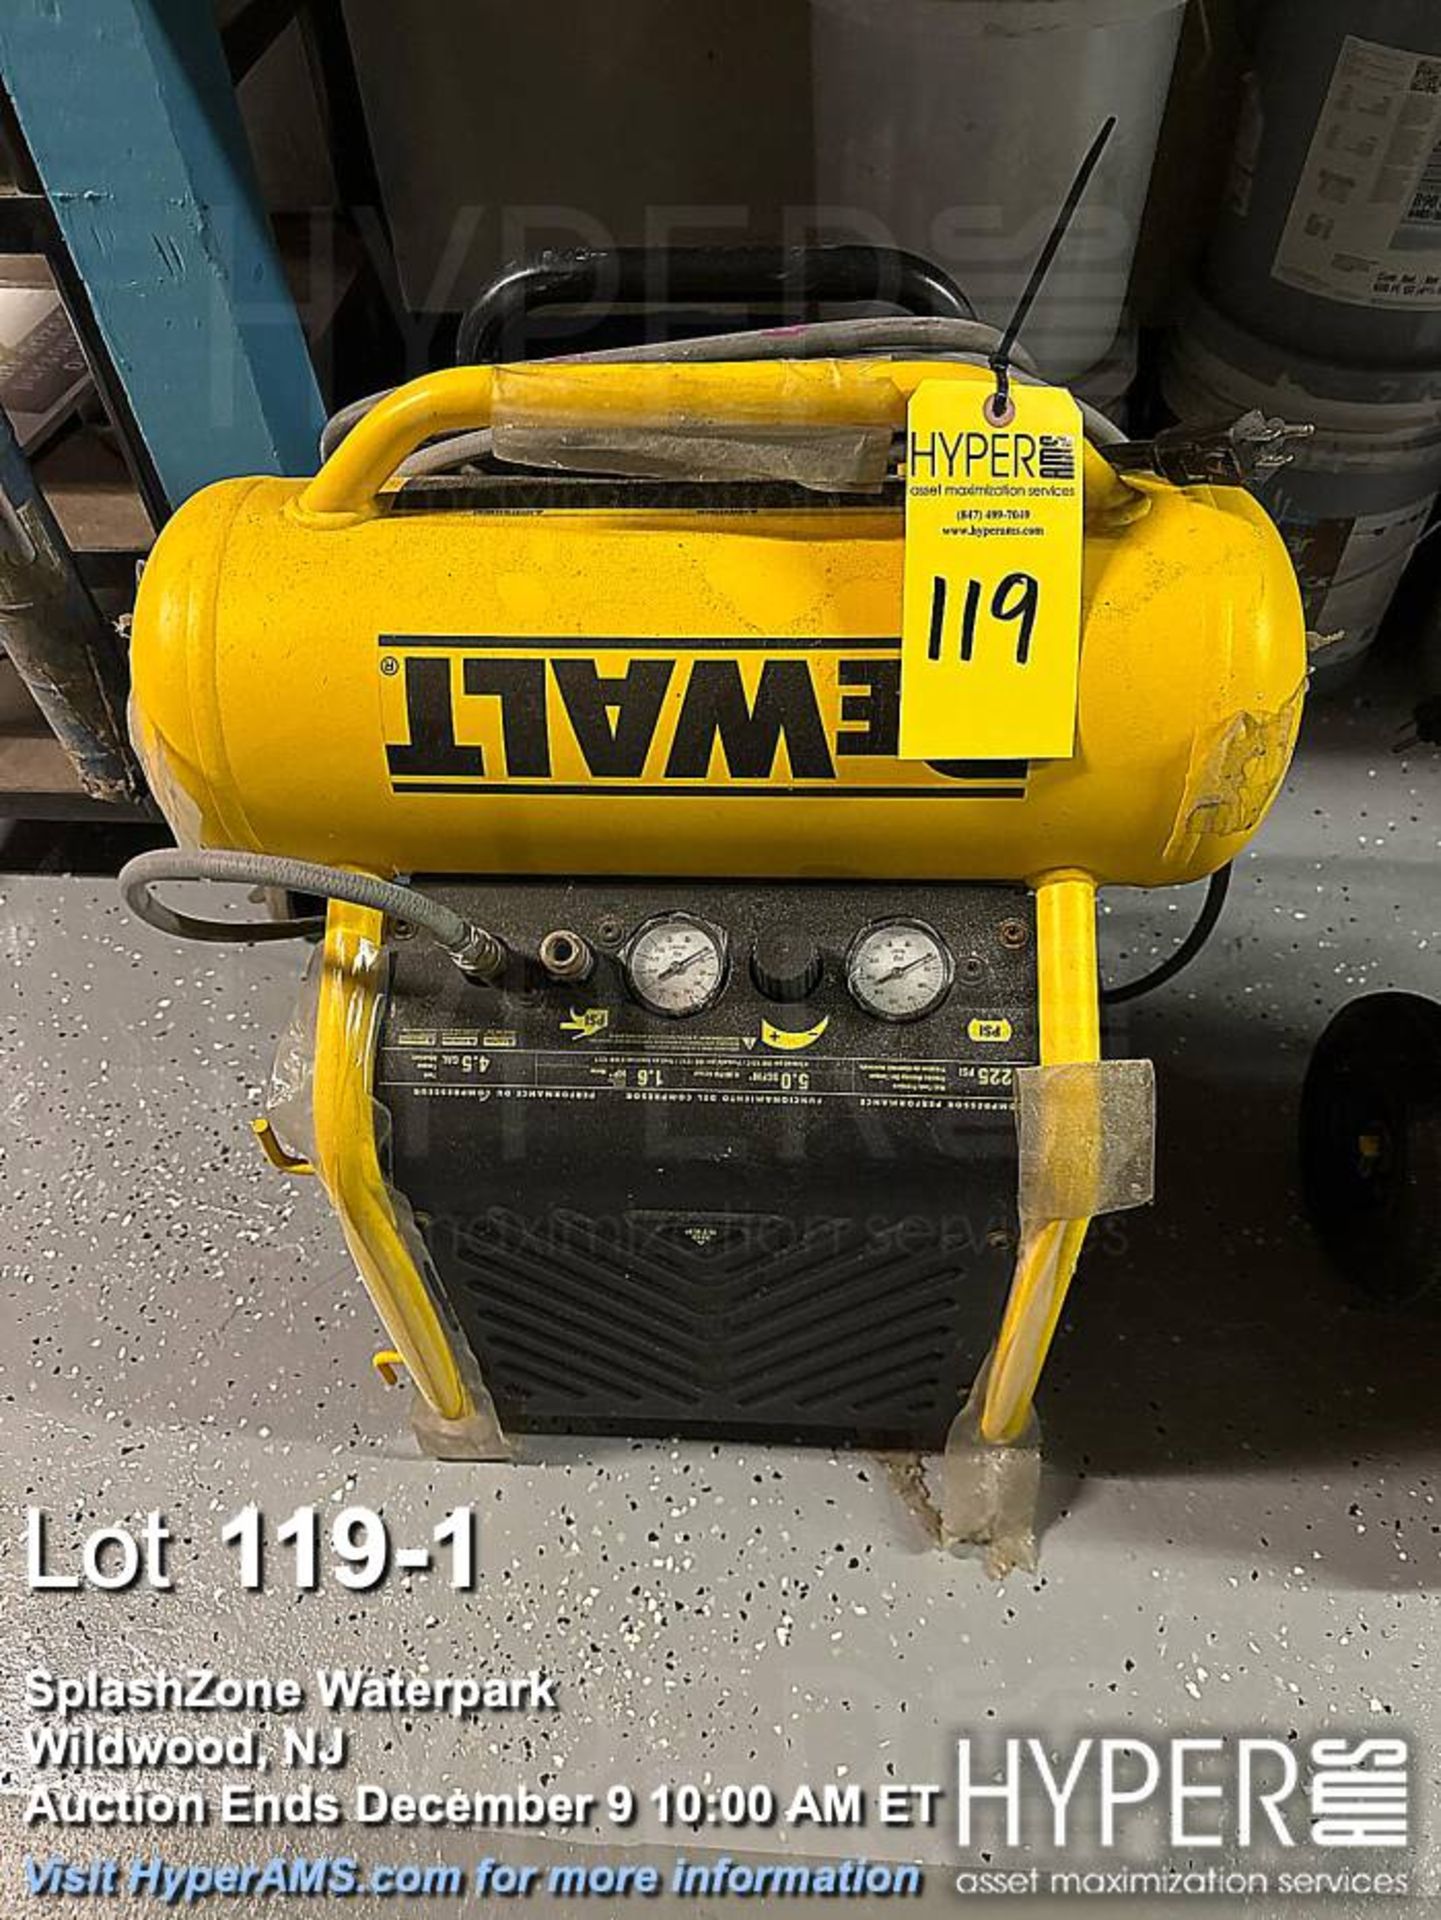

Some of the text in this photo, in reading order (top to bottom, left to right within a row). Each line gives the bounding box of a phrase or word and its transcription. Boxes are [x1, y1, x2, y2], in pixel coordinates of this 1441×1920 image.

[910, 432, 1036, 478] HYPER
[910, 484, 1075, 498] asset maximization services
[942, 524, 1044, 538] www.hyperams.com
[928, 573, 1038, 665] 119
[385, 657, 1027, 779] EWALT
[979, 1024, 1001, 1038] PSI
[461, 1056, 490, 1073] 4.5
[959, 1067, 975, 1077] PSI
[637, 1069, 664, 1086] 1.6
[781, 1072, 810, 1089] 5.0
[978, 1067, 1012, 1086] 225
[859, 1098, 942, 1108] PERFORMANCE
